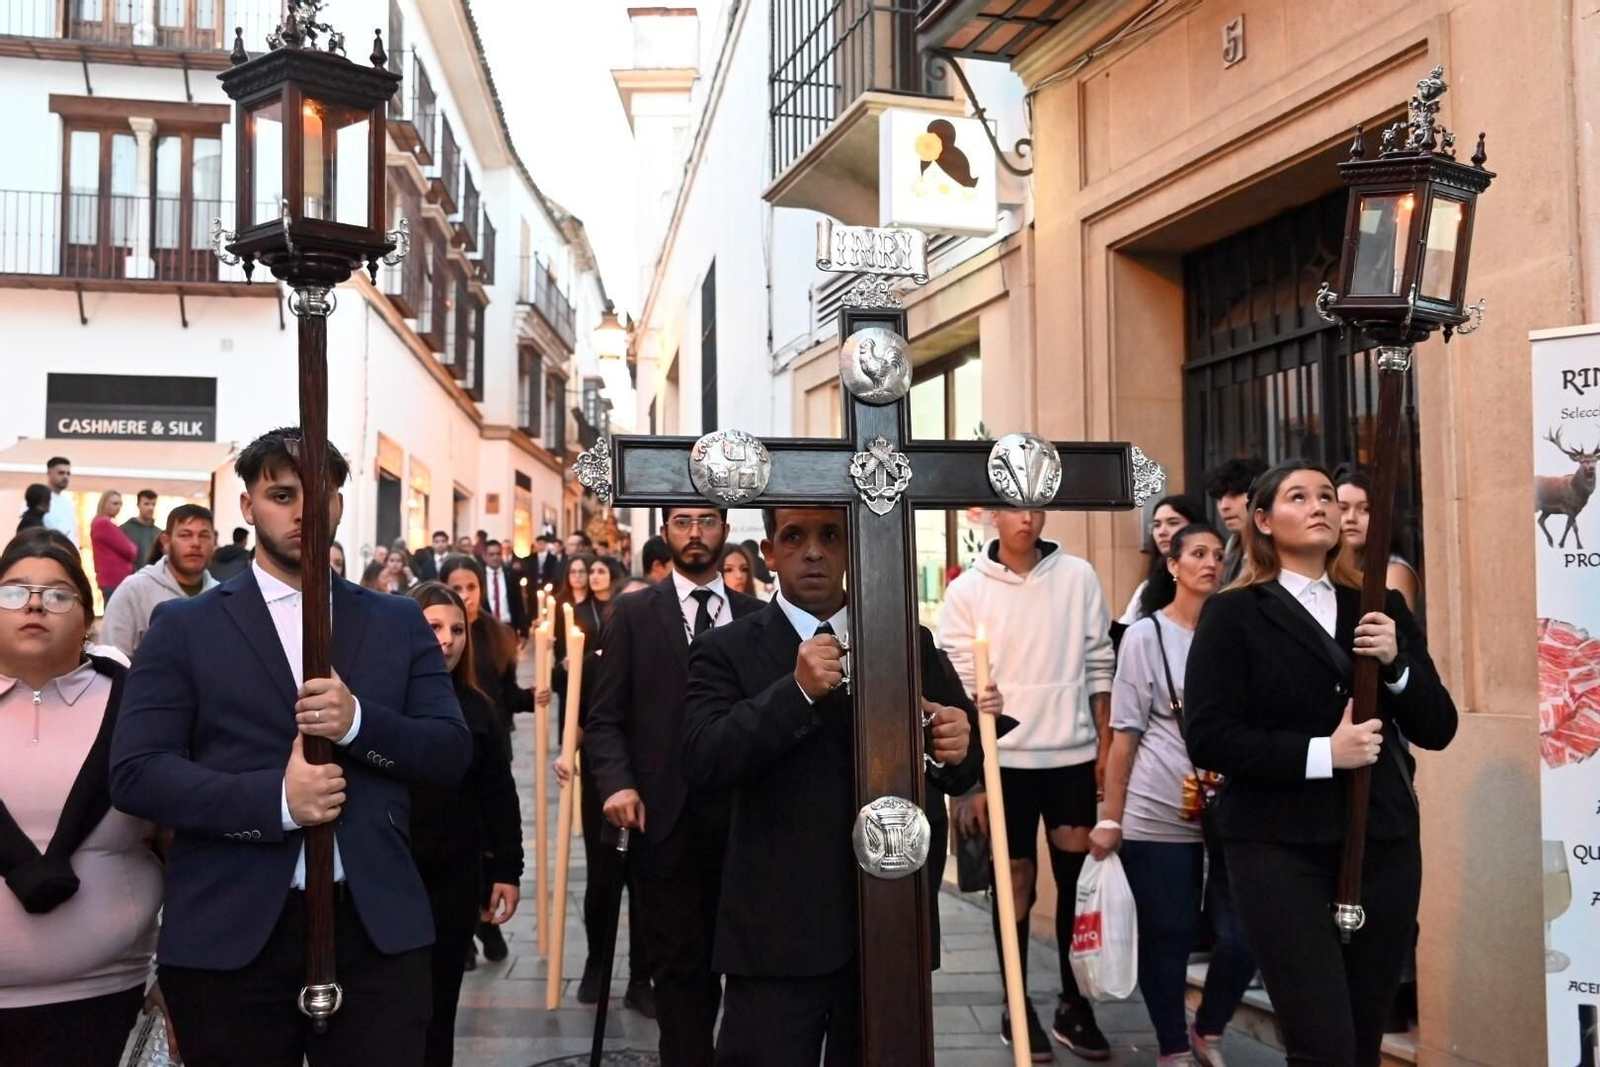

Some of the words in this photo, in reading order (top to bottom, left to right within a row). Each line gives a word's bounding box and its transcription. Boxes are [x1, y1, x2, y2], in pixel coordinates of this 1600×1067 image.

[1223, 20, 1239, 63] 5
[836, 231, 912, 270] INRI
[58, 418, 147, 435] CASHMERE
[151, 420, 164, 435] &
[169, 420, 203, 436] SILK
[1564, 552, 1600, 568] PRO
